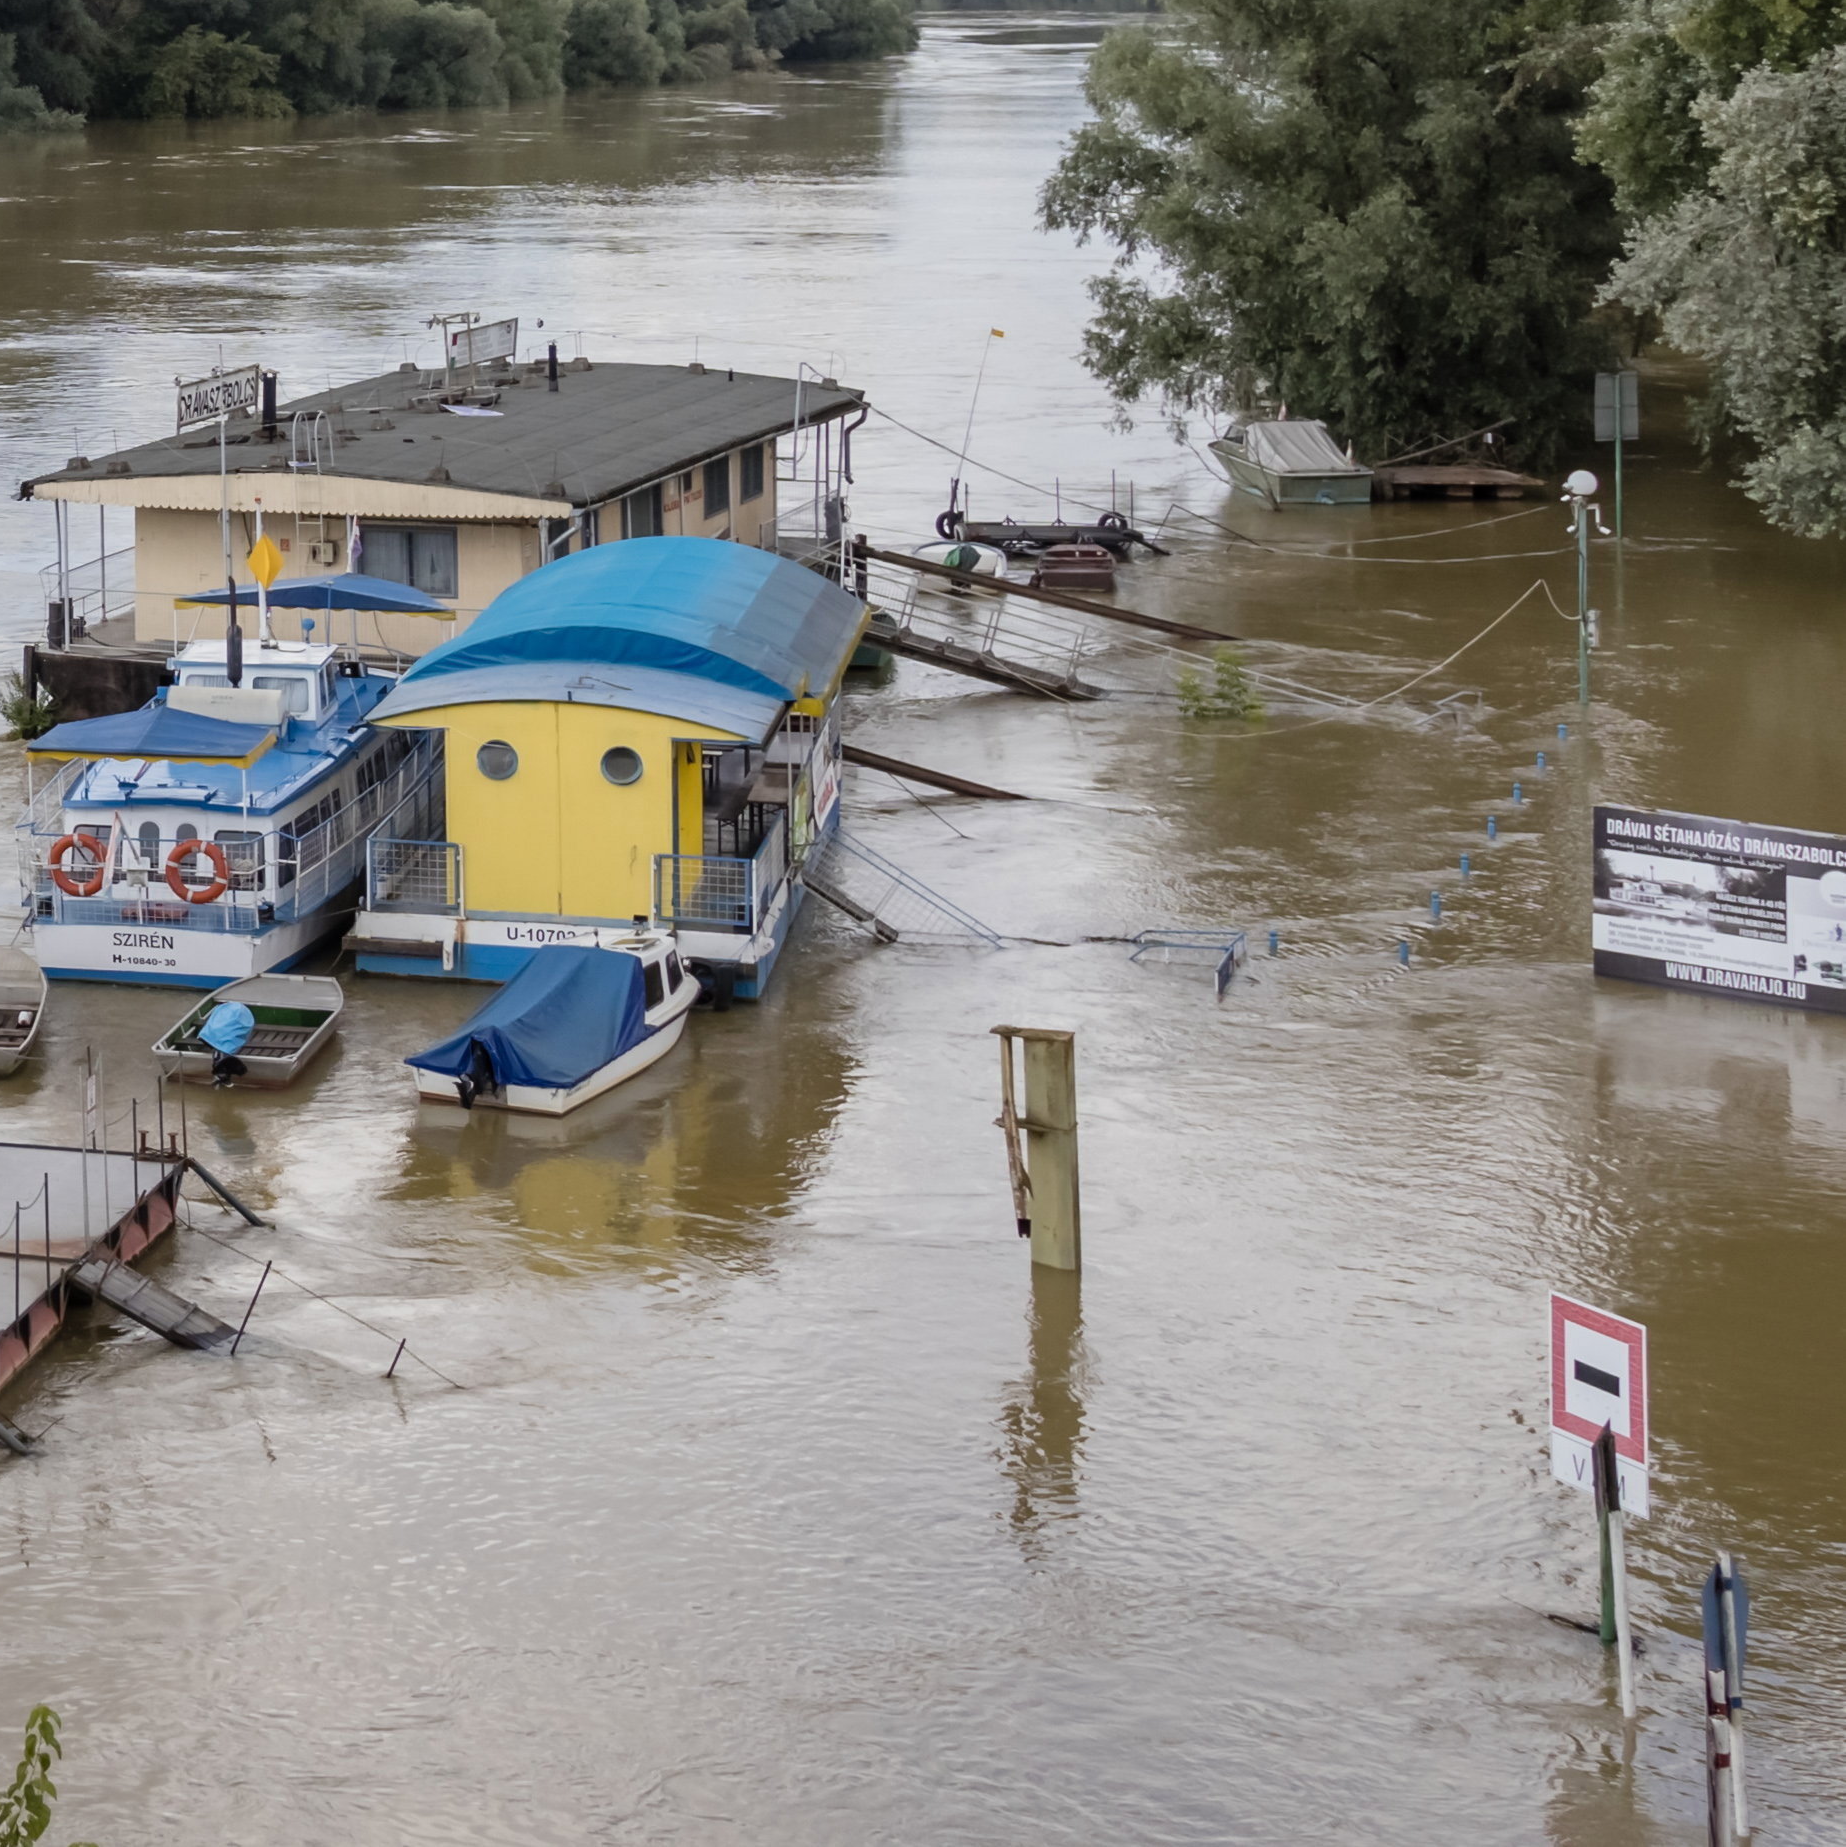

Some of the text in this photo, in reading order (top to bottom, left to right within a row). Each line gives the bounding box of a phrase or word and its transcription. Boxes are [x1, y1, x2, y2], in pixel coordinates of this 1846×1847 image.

[1606, 817, 1651, 840] DRÁVAI
[1654, 823, 1741, 853] SÉTAHAJÓZÁS
[112, 931, 174, 949] SZIRÉN
[1665, 961, 1807, 1000] WWW.DRAVAHAJO.HU
